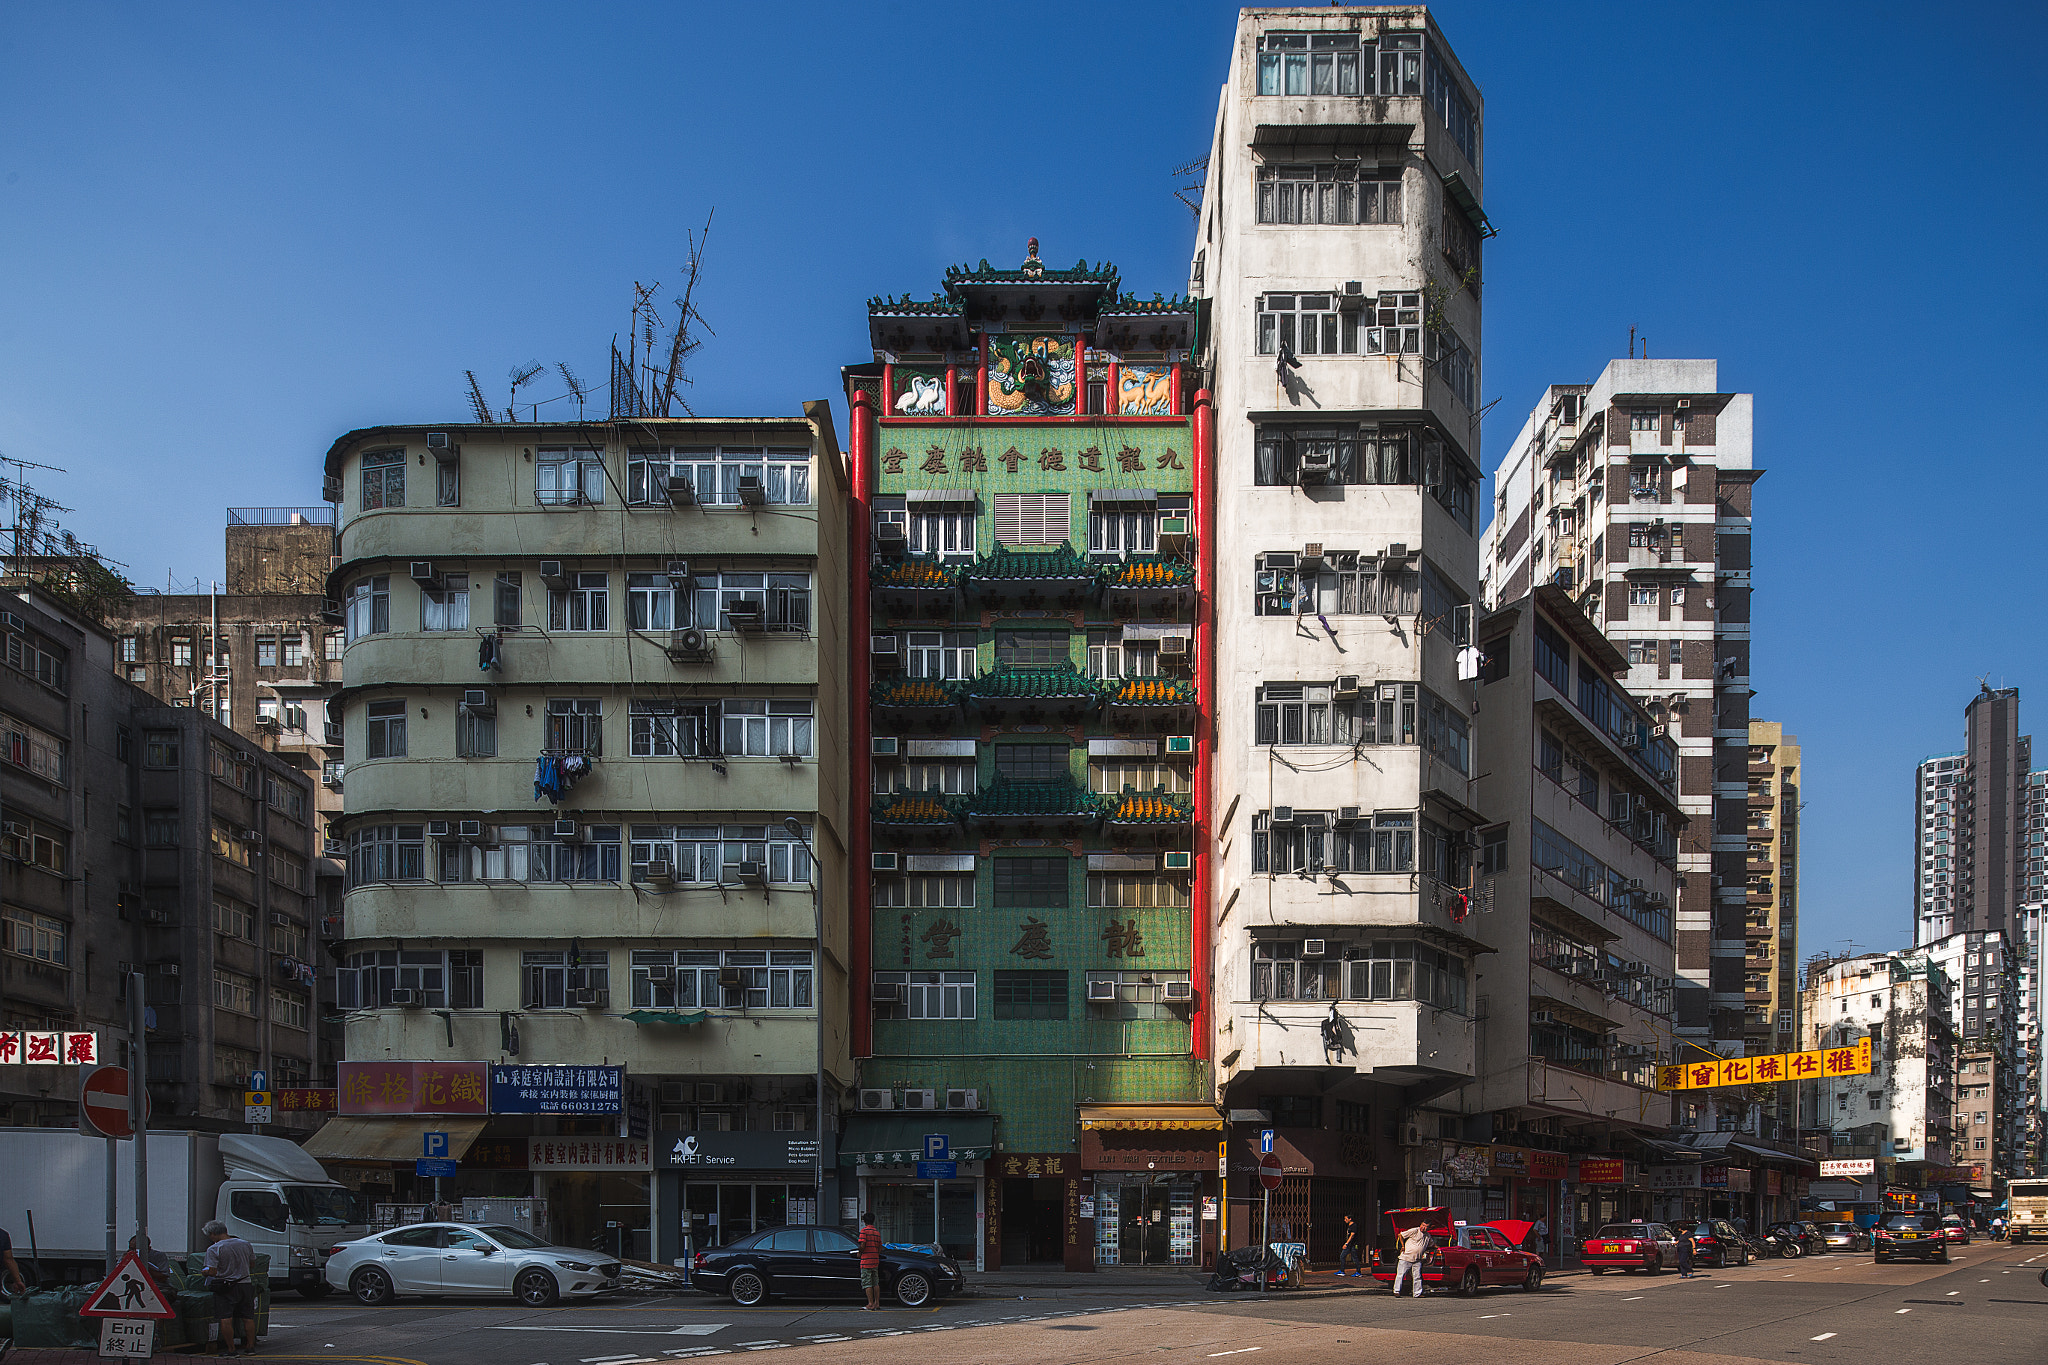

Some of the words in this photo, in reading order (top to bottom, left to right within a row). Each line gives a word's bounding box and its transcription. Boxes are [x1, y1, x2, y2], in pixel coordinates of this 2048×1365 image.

[561, 1101, 619, 1111] 66031278
[428, 1134, 444, 1155] P
[928, 1137, 944, 1158] P
[705, 1155, 735, 1165] Service
[855, 1149, 977, 1164] 龍慶堂西診所
[1147, 1155, 1186, 1163] TEXTILES
[111, 1322, 145, 1335] End
[105, 1337, 146, 1353] 終止
